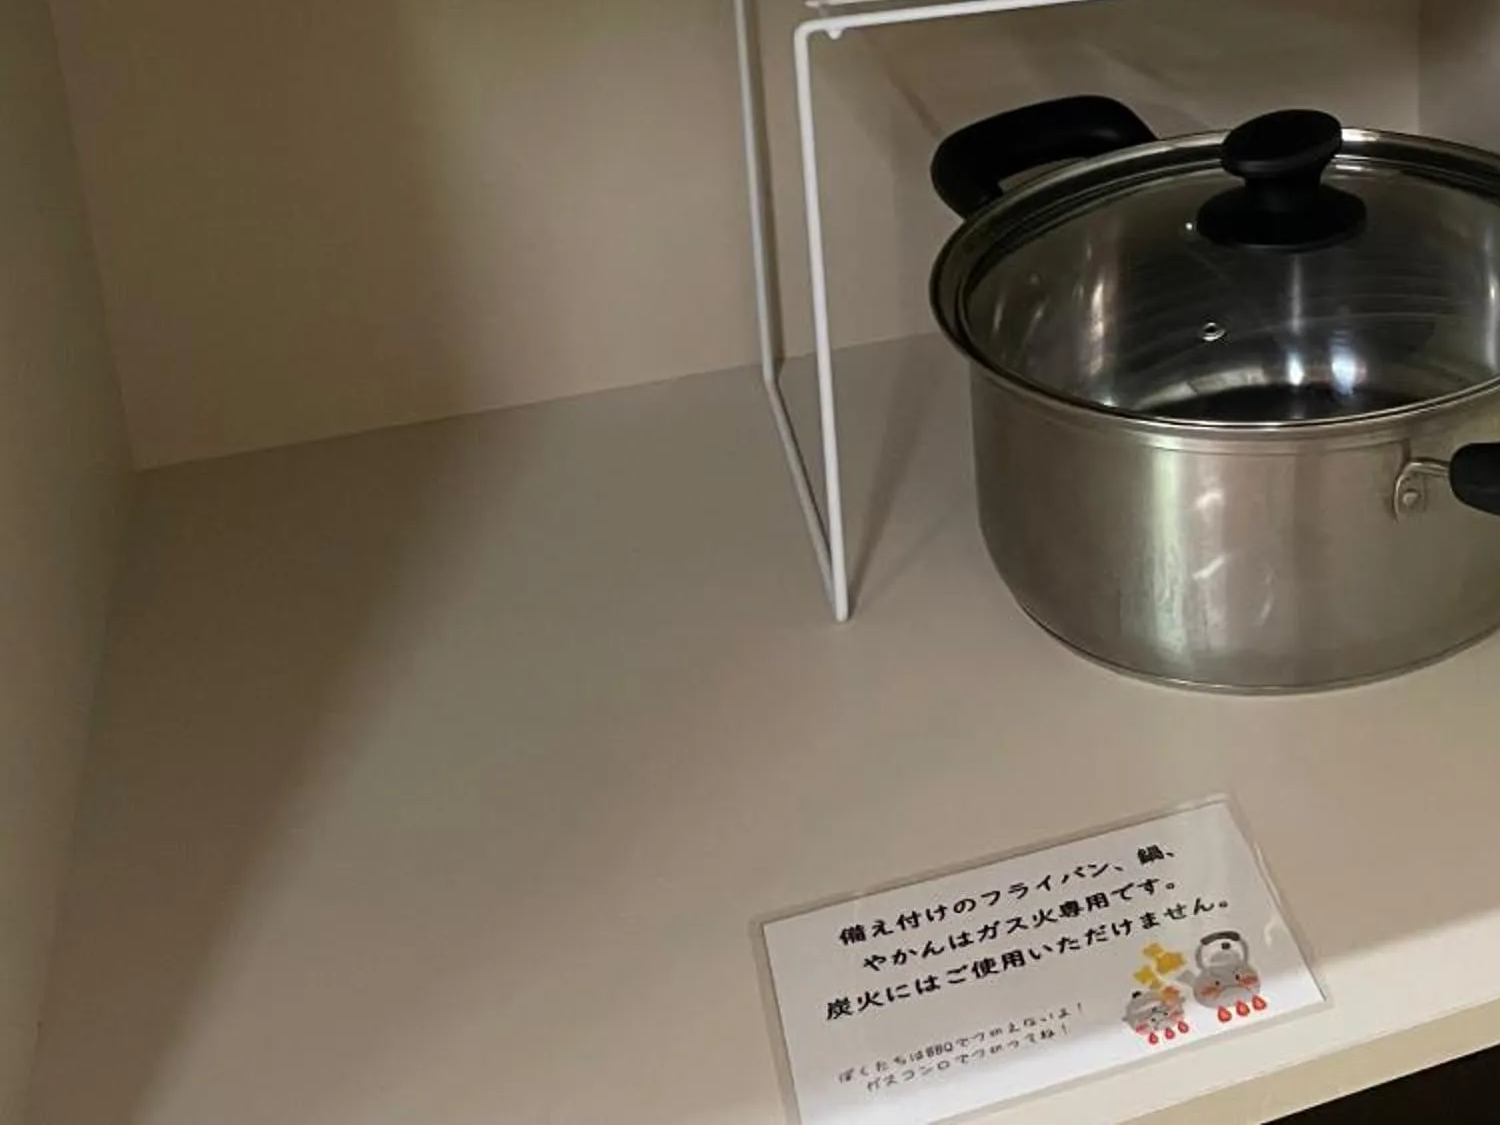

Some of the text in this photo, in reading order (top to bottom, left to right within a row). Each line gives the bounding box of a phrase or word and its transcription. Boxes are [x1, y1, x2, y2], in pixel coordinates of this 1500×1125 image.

[839, 843, 1176, 946] 備え付けのフライパン、鍋、
[863, 878, 1176, 972] やかんはガス火専用です。
[826, 898, 1229, 1021] 炭火にはご使用いただけません。
